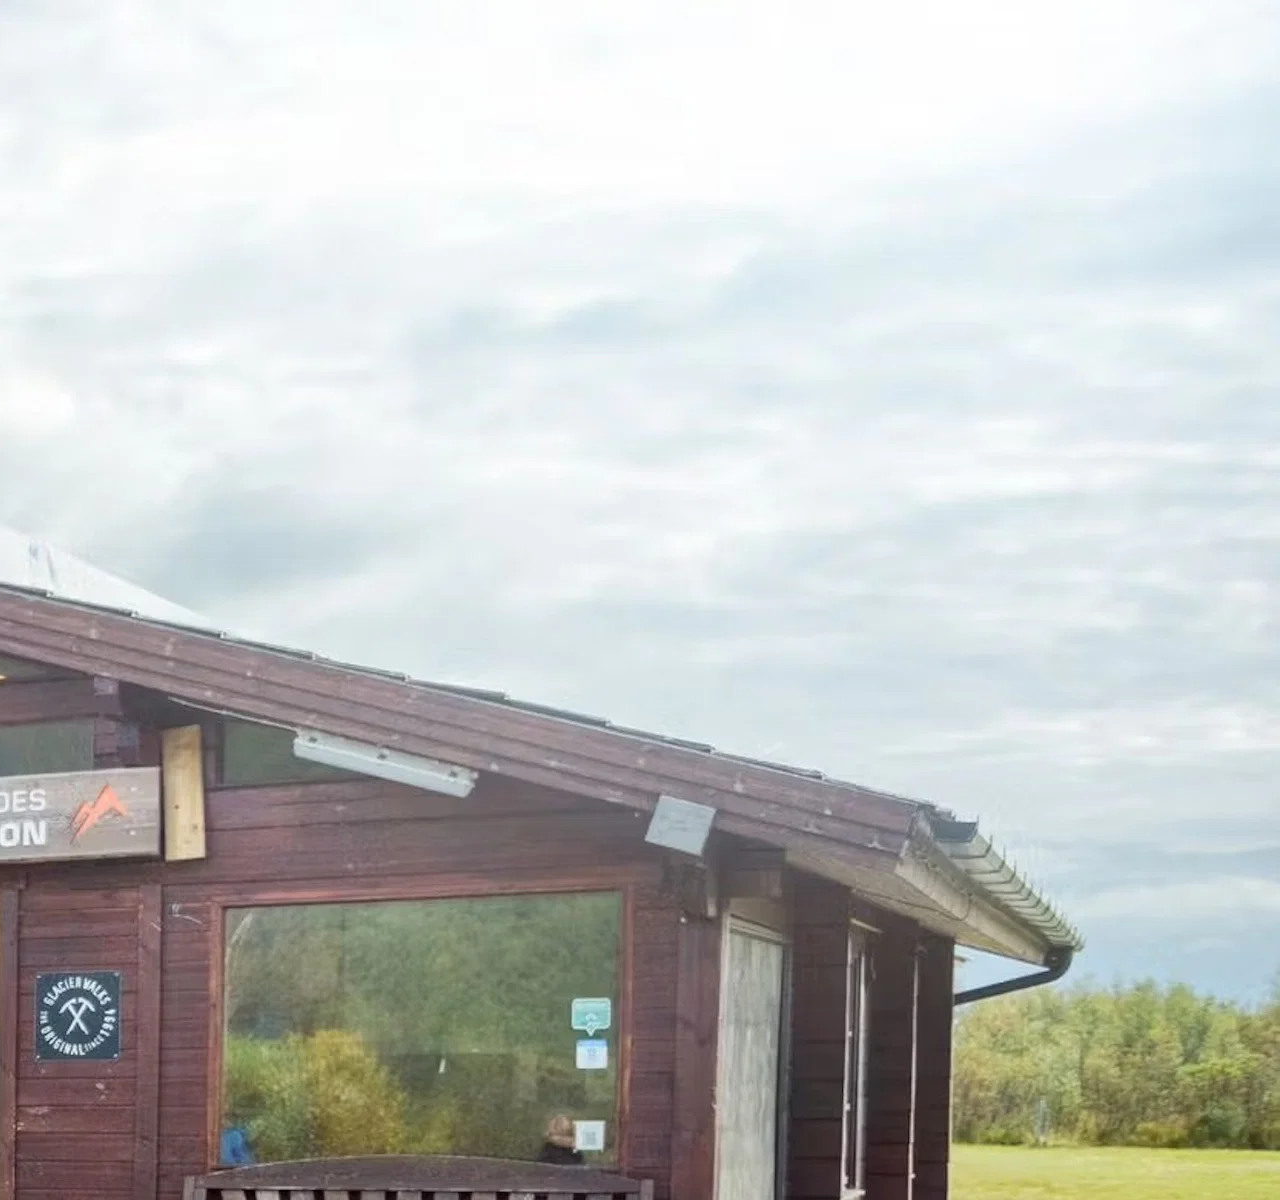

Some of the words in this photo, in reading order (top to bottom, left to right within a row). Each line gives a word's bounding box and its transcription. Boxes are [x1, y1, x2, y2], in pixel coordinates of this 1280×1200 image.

[42, 976, 82, 1006] GLACIER
[83, 978, 113, 1005] WALKS
[40, 1026, 87, 1056] ORIGINAL
